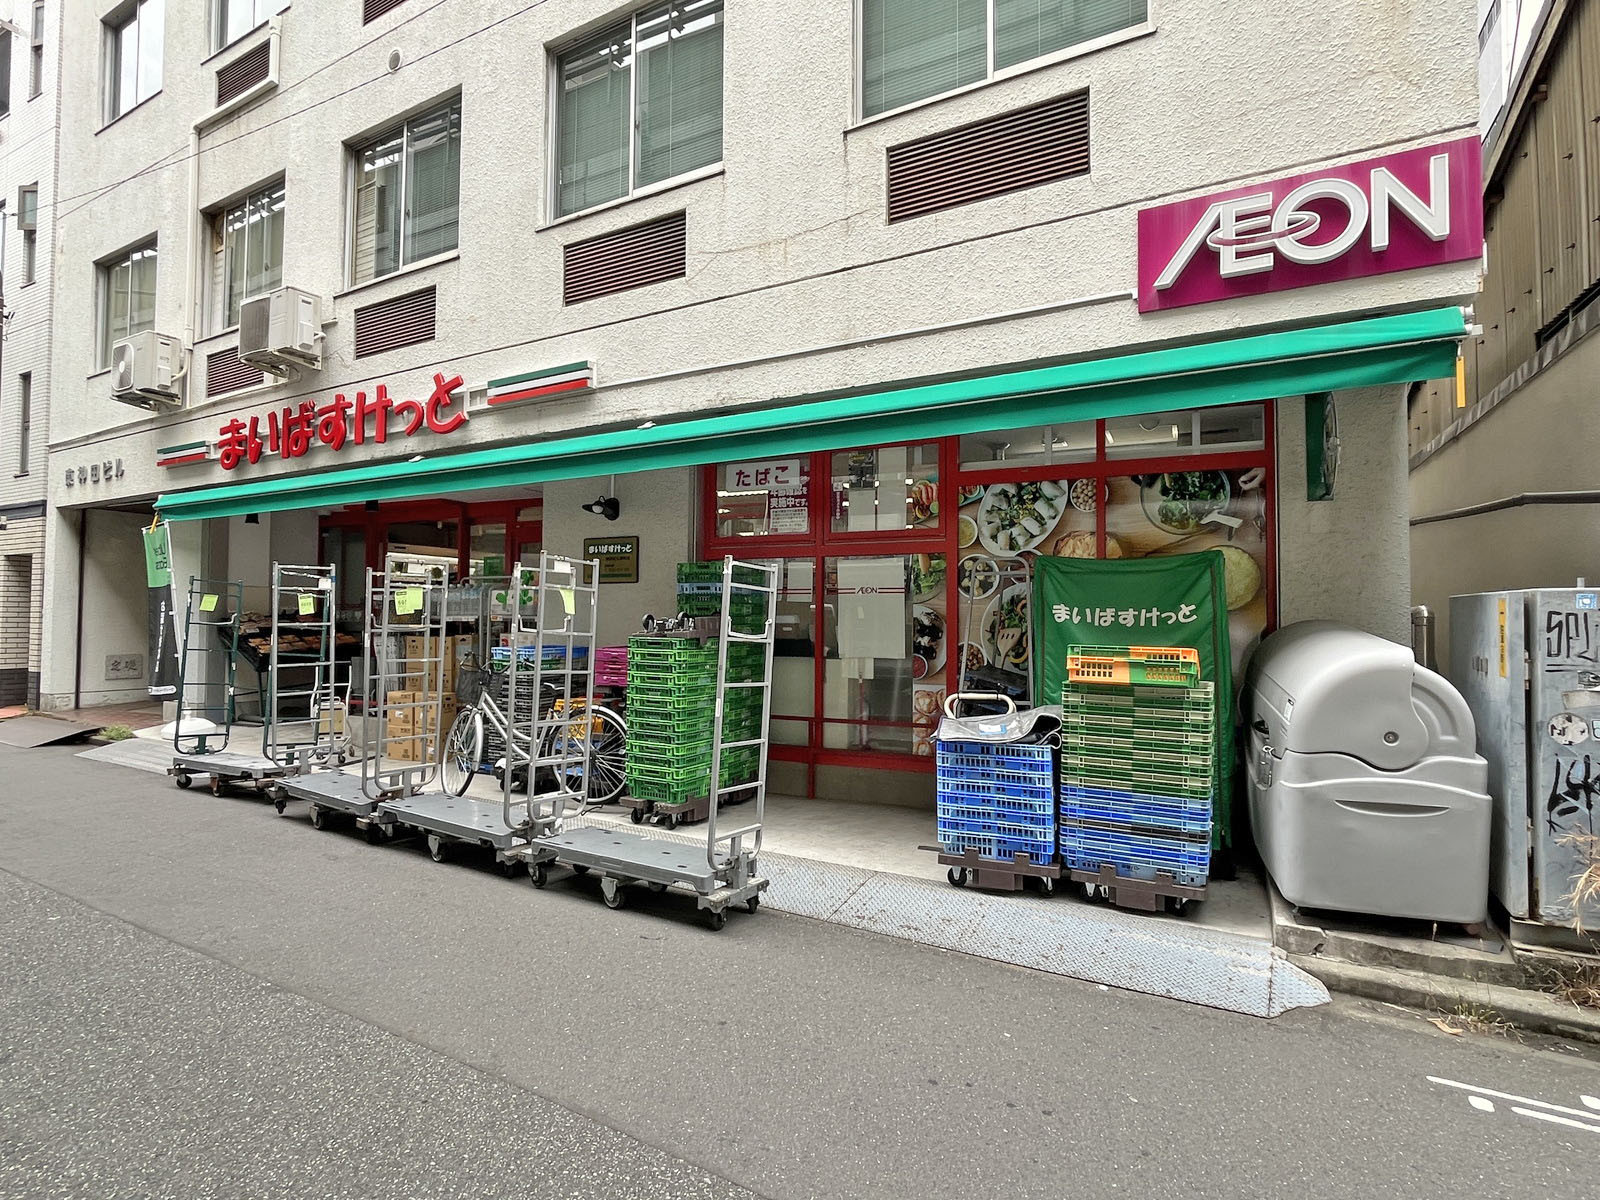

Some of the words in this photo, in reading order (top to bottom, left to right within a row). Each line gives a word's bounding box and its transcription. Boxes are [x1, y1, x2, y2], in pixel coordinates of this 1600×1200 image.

[218, 372, 468, 470] まいばすけっと
[736, 466, 789, 487] たばこ
[1052, 603, 1198, 627] まいばすけっと
